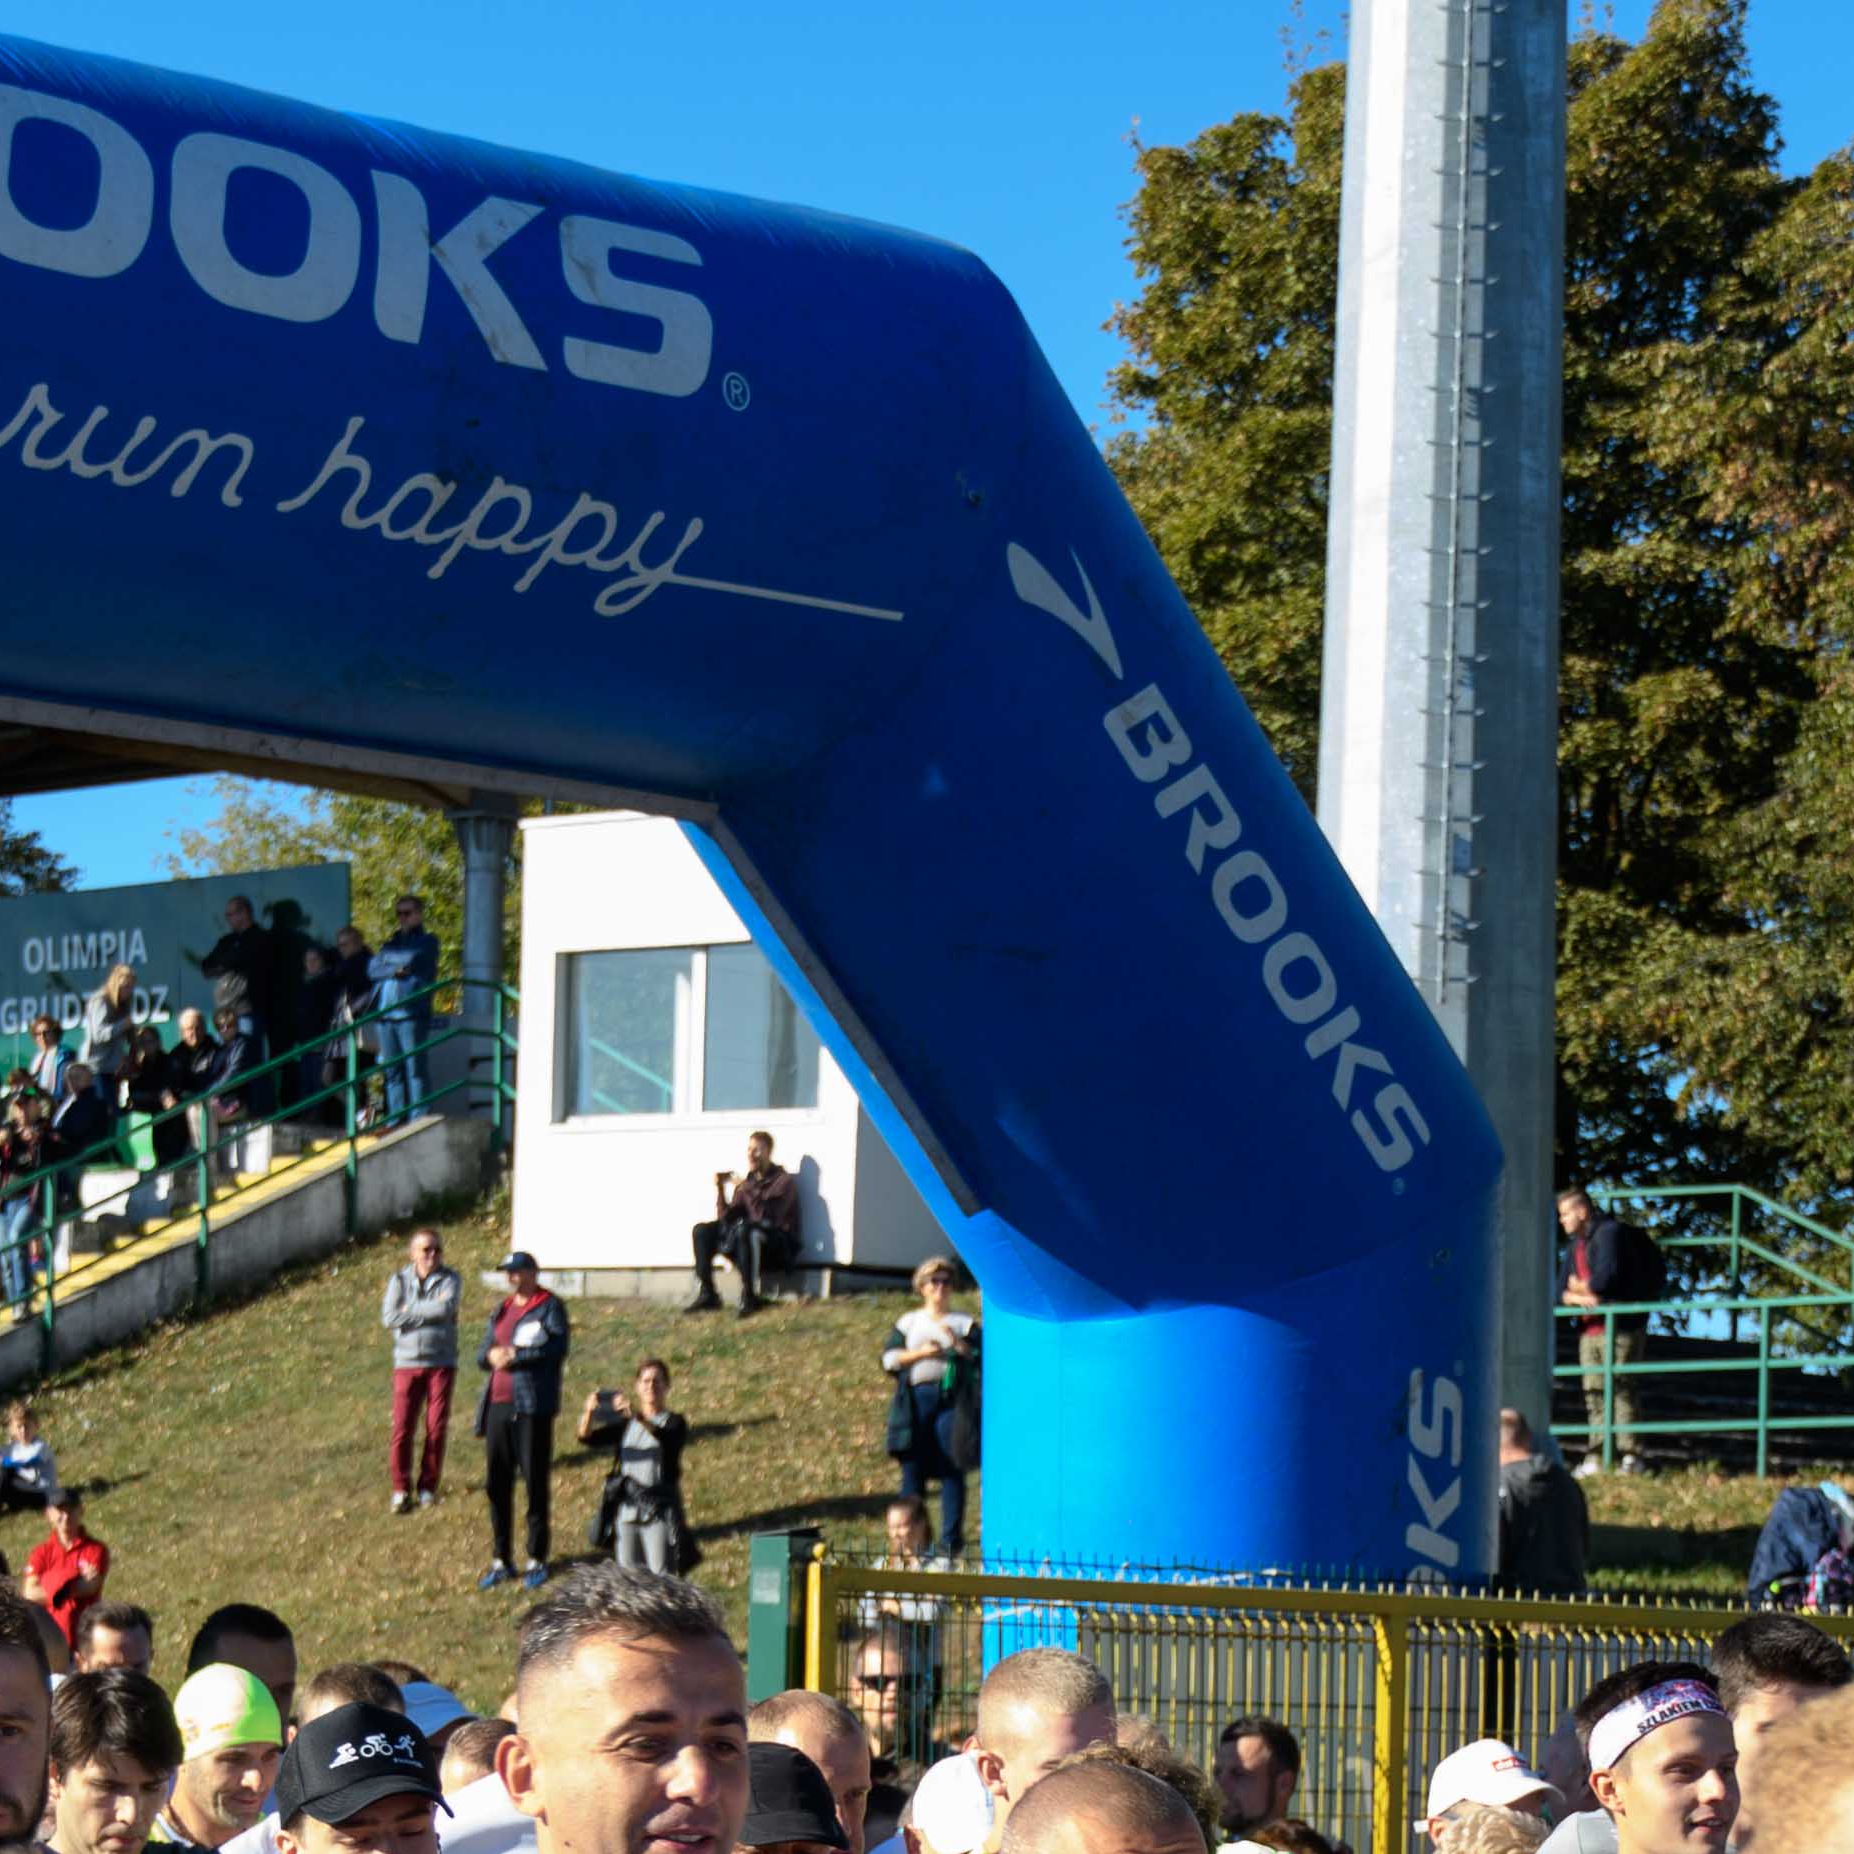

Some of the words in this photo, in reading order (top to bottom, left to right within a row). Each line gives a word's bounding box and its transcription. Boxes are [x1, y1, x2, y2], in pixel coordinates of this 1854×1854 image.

[278, 415, 703, 617] happy
[23, 928, 147, 973] OLIMPIA
[1102, 682, 1431, 1172] BROOKS
[0, 985, 170, 1035] GRUDDZ
